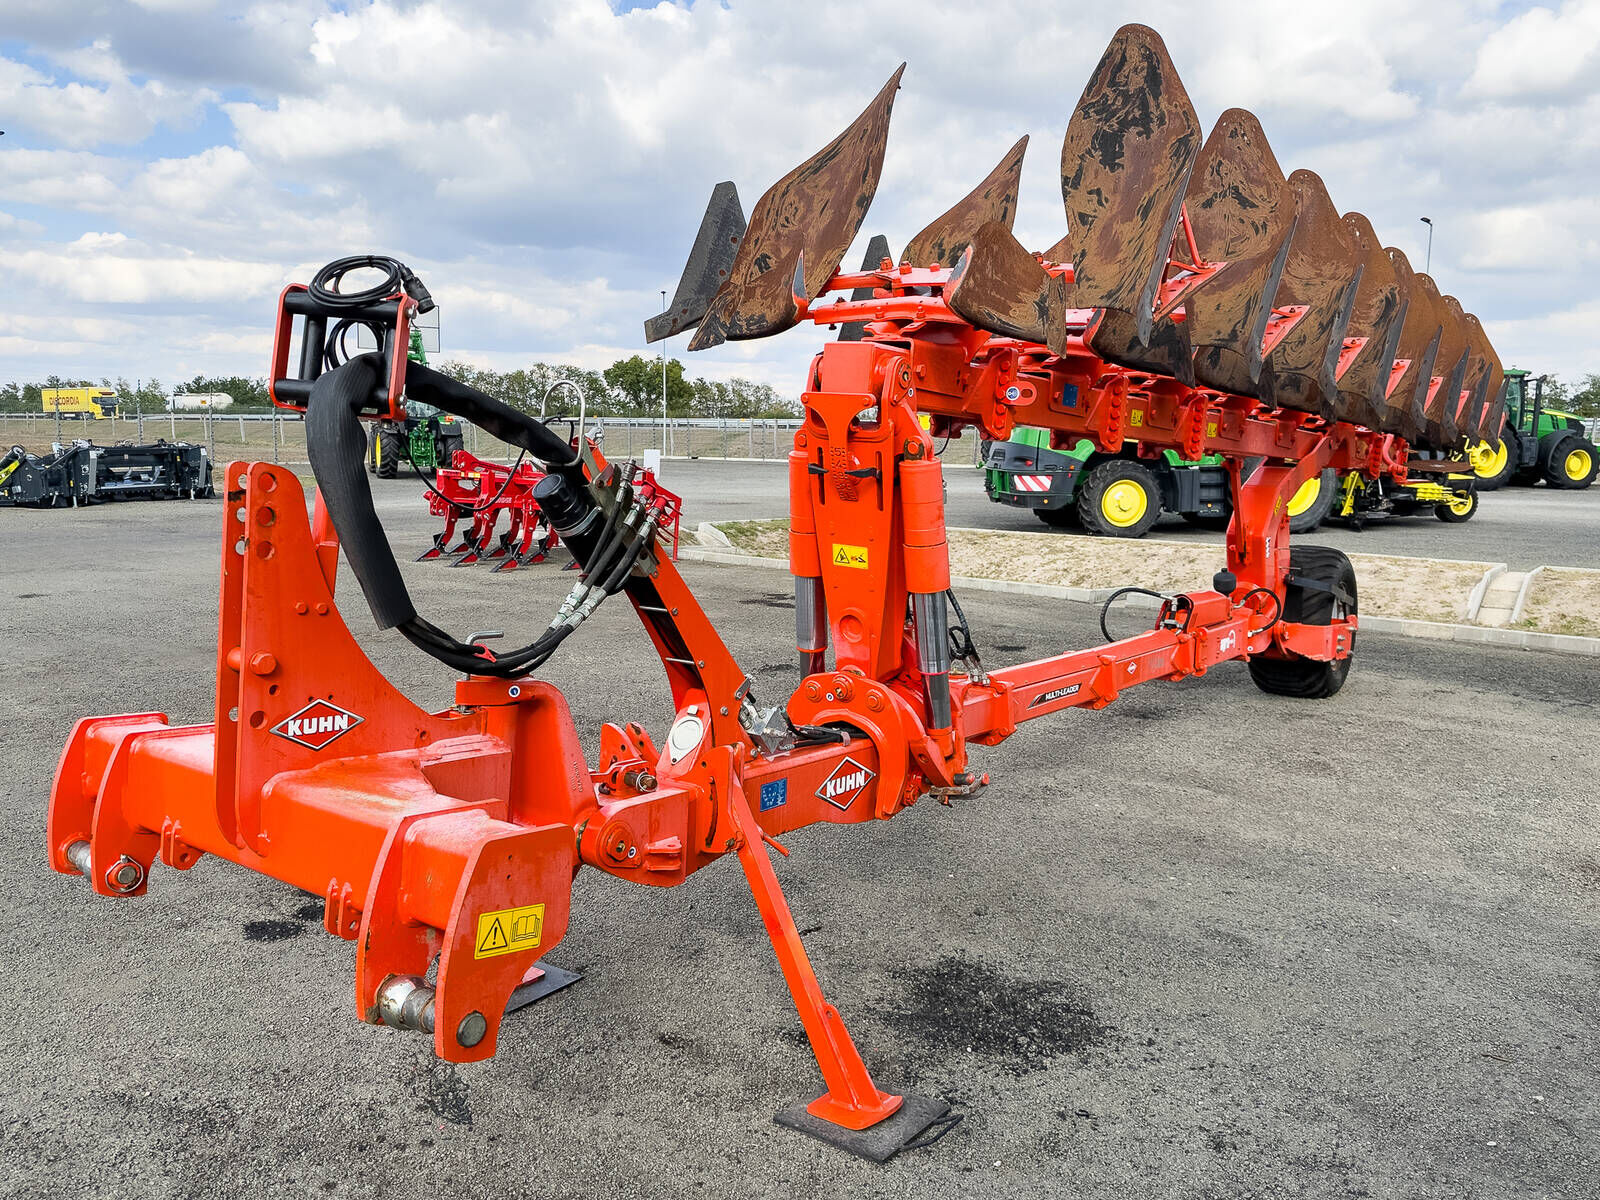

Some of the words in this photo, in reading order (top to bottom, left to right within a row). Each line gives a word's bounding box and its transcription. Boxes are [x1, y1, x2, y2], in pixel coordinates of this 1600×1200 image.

[1045, 684, 1080, 700] MULTI-LEADER
[287, 714, 349, 737] KUHN
[826, 769, 866, 798] KUHN
